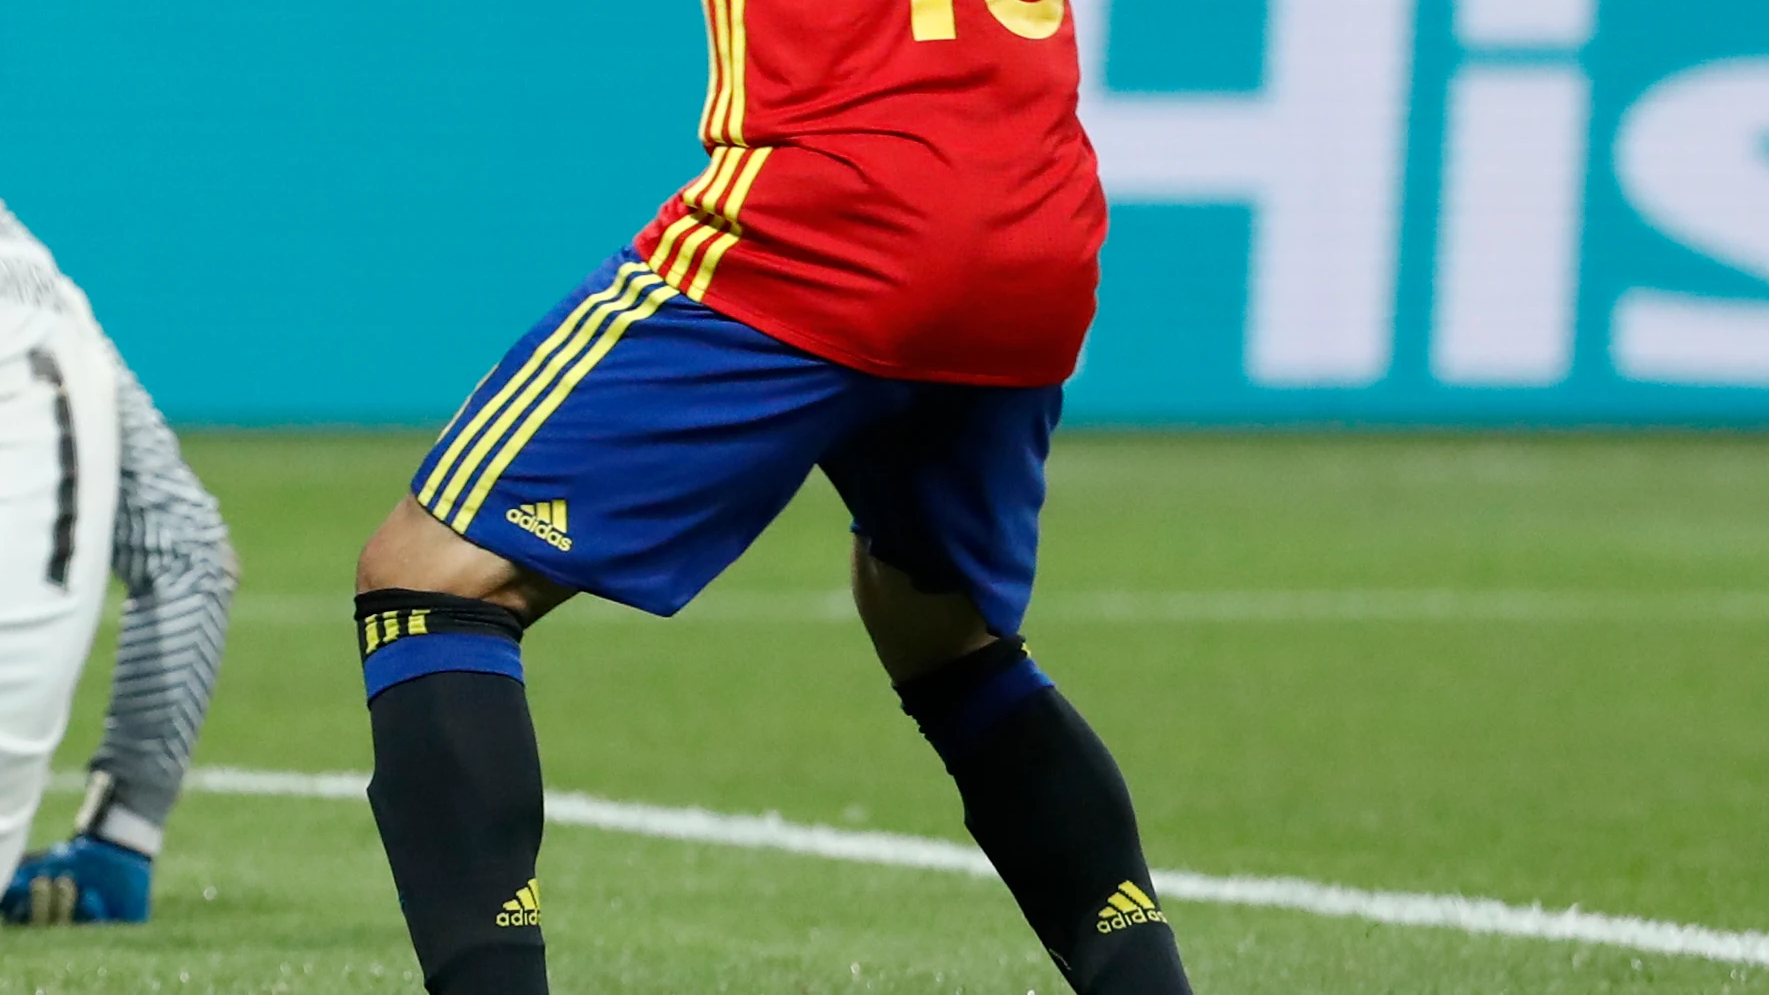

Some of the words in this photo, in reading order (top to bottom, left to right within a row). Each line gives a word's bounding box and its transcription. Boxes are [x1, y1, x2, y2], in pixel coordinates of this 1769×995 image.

[28, 348, 79, 585] 1
[505, 508, 573, 552] adidas
[495, 908, 541, 927] adid
